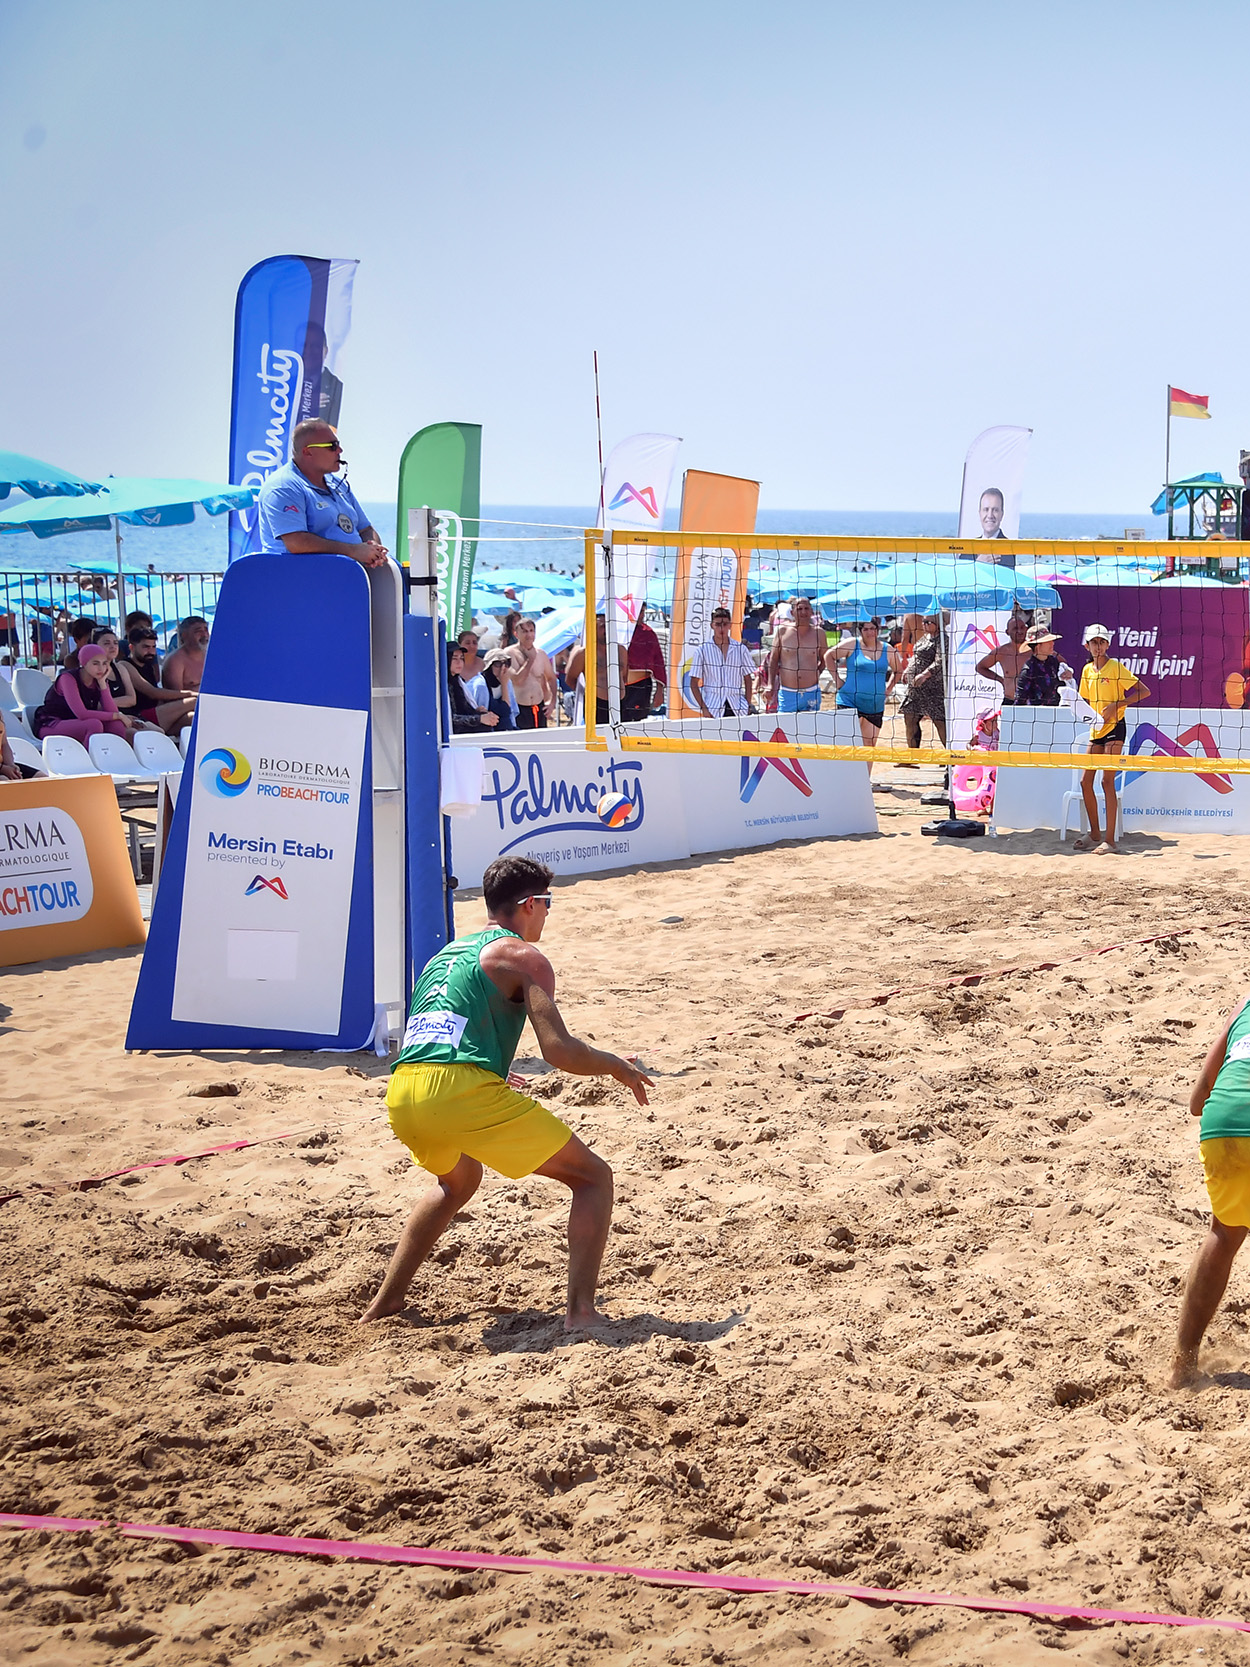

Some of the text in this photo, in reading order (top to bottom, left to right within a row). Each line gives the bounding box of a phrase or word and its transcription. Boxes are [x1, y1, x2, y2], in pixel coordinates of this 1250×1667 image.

[1118, 627, 1158, 648] Yeni
[1151, 650, 1195, 680] İçin!
[259, 757, 351, 779] BIODERMA
[256, 783, 350, 805] PROBEACHTOUR
[481, 747, 645, 833] Palmcity
[1122, 806, 1144, 815] ERSİN
[207, 831, 334, 860] Mersin Etabı
[562, 849, 571, 860] ve
[600, 840, 630, 855] Merkezi
[207, 853, 286, 870] presented by
